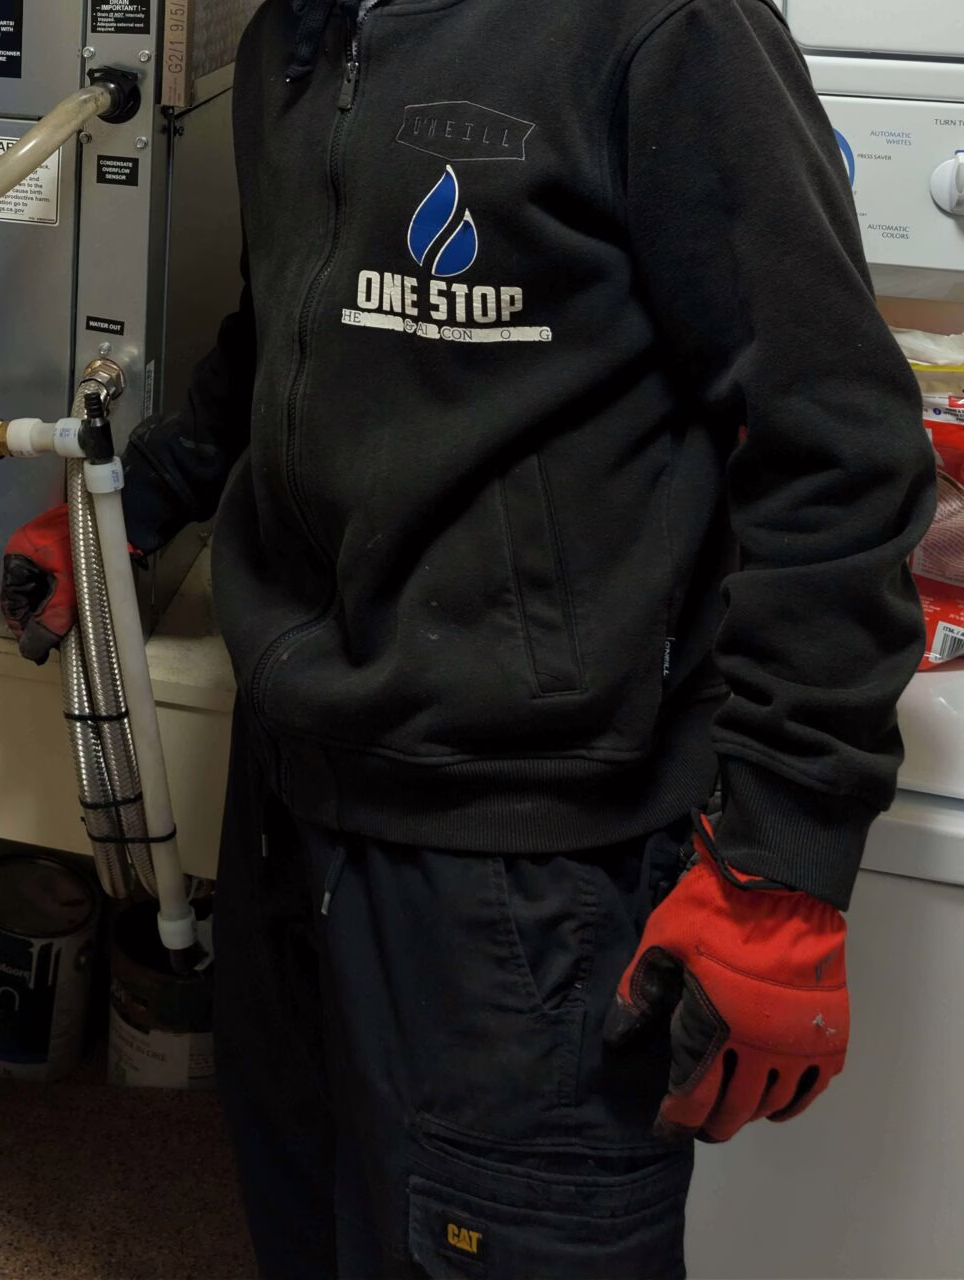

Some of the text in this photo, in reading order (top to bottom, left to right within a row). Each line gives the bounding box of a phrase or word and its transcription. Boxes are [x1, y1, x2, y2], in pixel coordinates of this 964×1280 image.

[167, 40, 184, 74] G2/1
[414, 116, 510, 148] O'NEILL
[870, 130, 912, 138] AUTOMATIC
[867, 224, 909, 232] AUTOMATIC
[881, 231, 909, 239] COLORS
[357, 269, 419, 316] ONE
[429, 279, 523, 323] STOP
[89, 321, 108, 329] WATER
[447, 1223, 483, 1254] CAT
